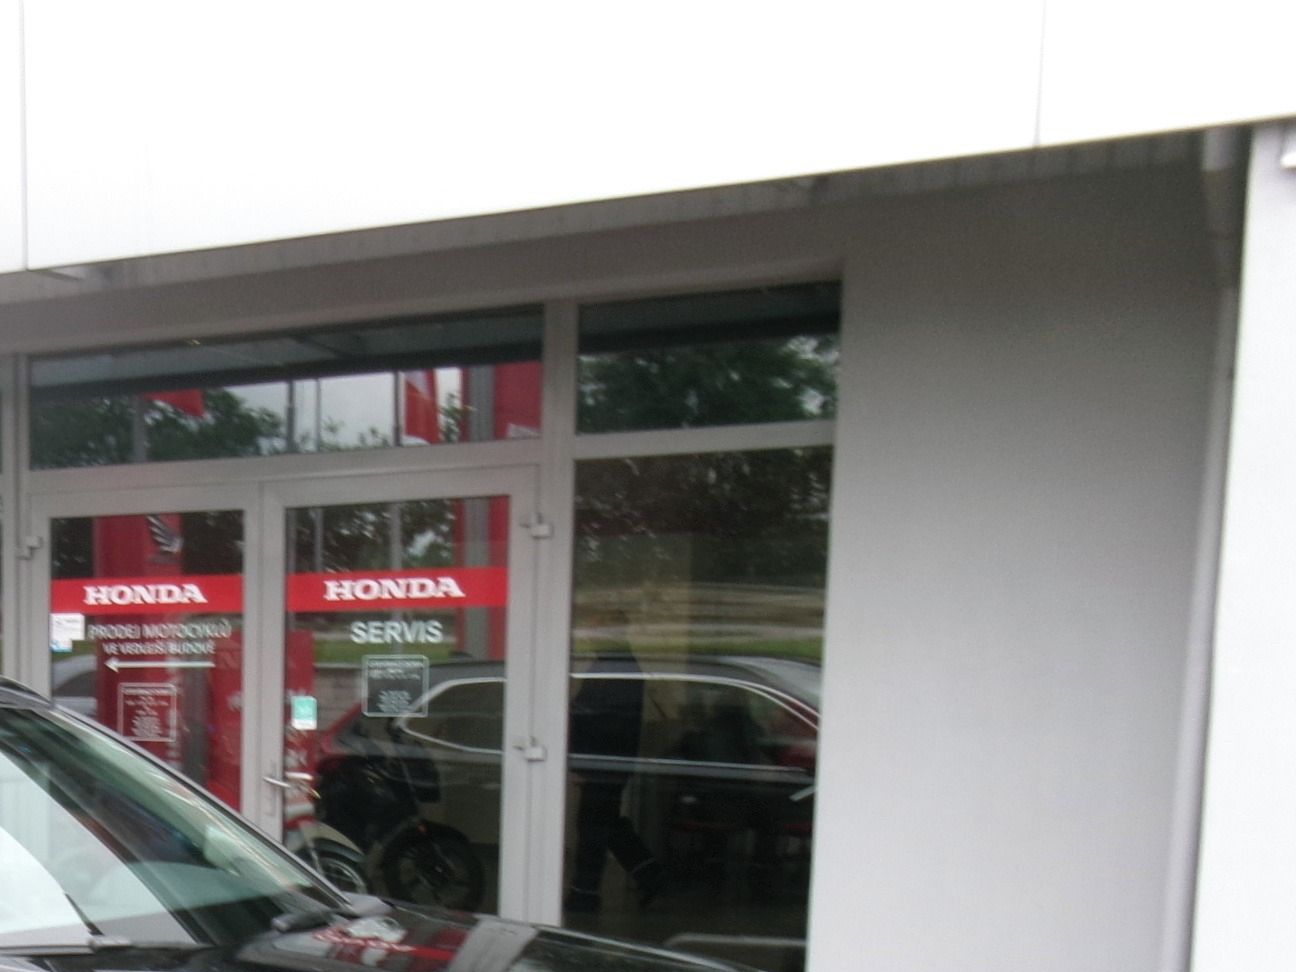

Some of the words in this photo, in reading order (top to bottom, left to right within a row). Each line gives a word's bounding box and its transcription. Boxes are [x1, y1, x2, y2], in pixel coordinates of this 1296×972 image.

[83, 583, 208, 605] HONDA
[323, 576, 466, 601] HONDA
[350, 620, 444, 645] SERVIS
